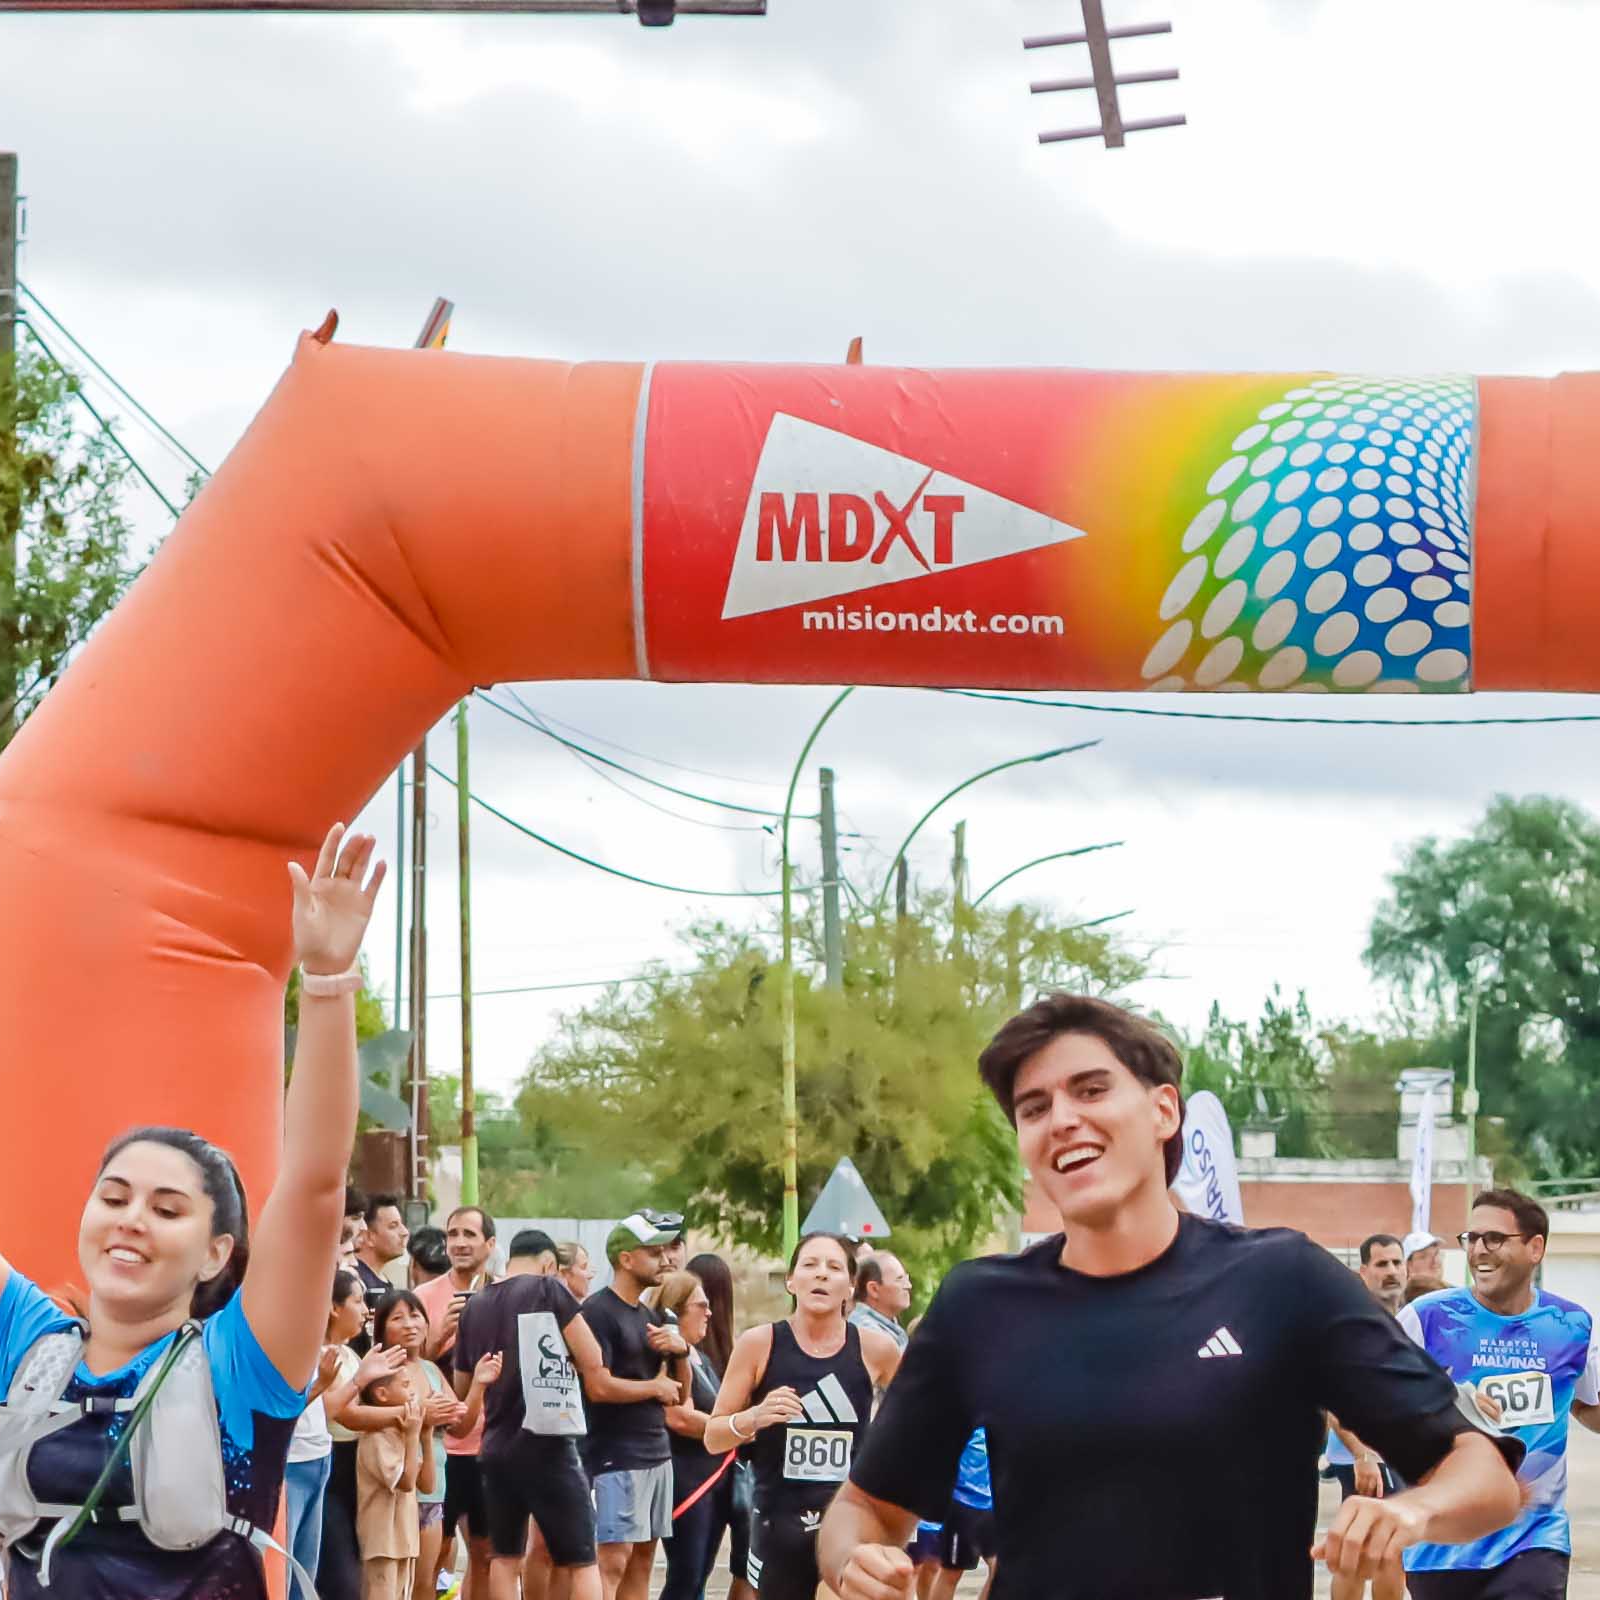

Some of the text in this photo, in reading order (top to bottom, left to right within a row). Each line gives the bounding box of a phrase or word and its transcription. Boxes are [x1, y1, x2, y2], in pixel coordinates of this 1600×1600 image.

[756, 470, 965, 572] MDXT
[802, 604, 1064, 635] misiondxt.com
[1471, 1353, 1547, 1371] MALVINAS
[1485, 1376, 1544, 1412] 667
[788, 1435, 847, 1467] 860
